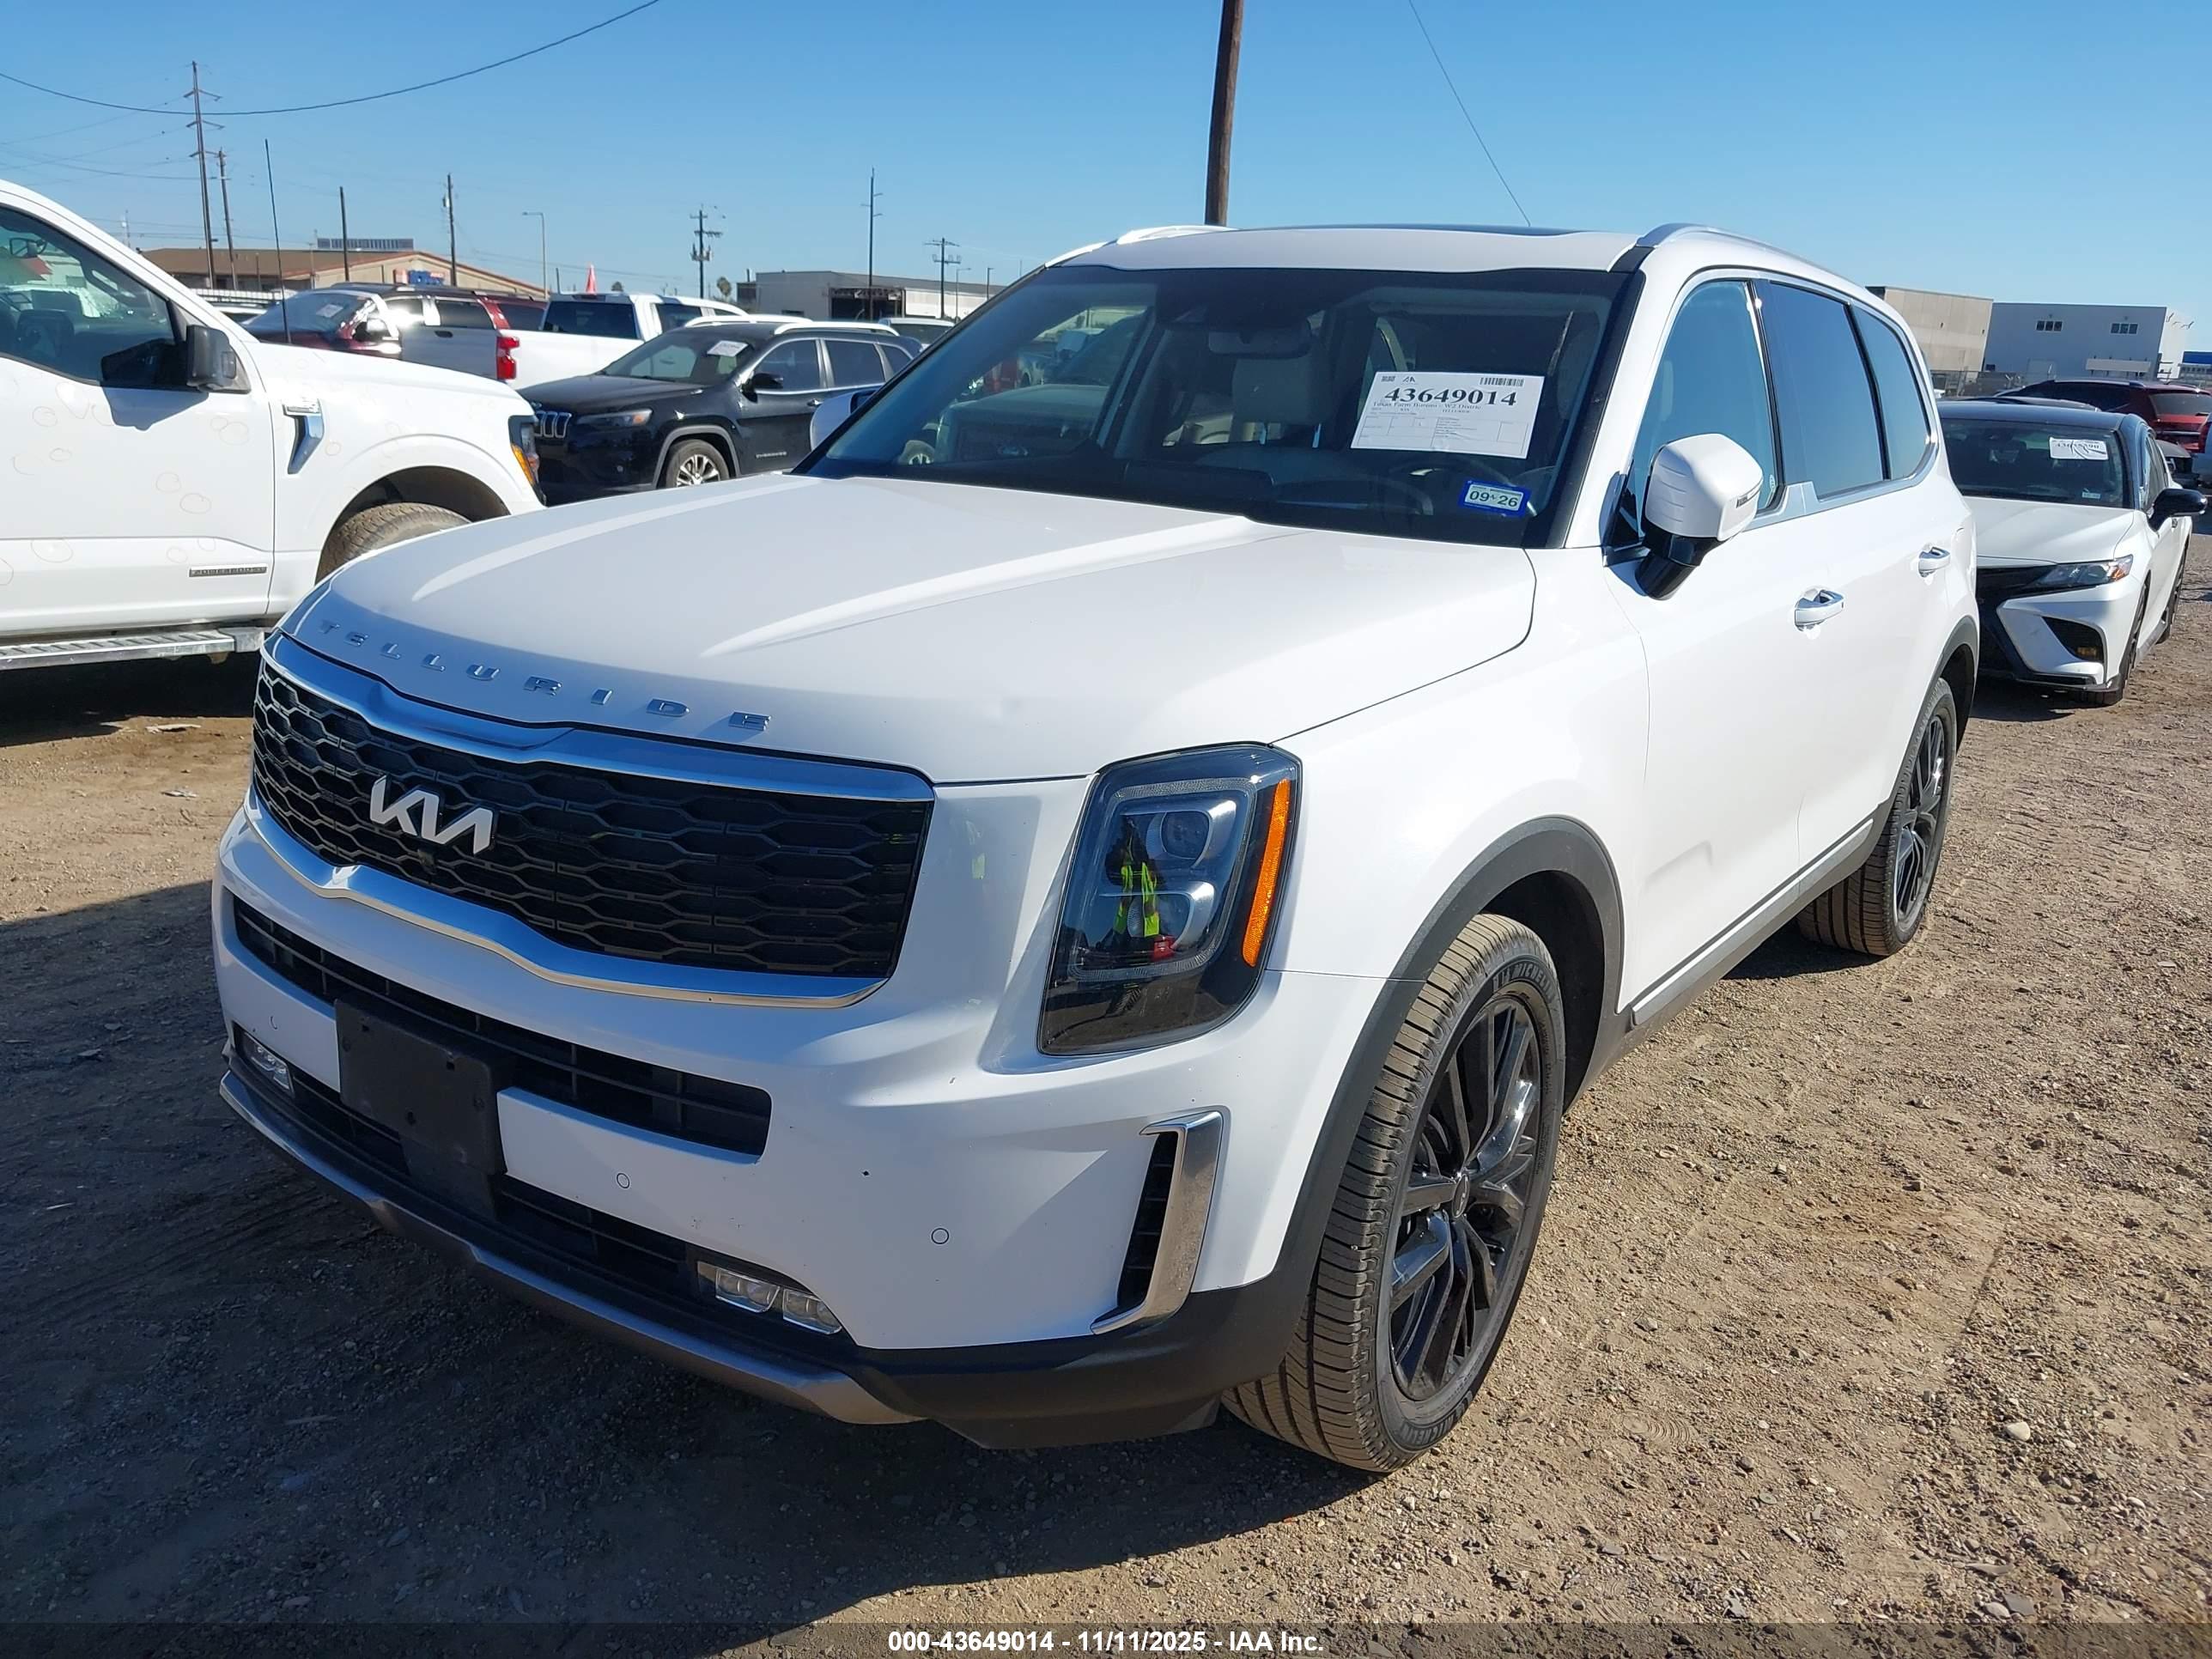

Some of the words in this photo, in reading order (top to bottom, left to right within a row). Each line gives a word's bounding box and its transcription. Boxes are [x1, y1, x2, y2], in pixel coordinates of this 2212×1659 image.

[1384, 387, 1517, 406] 43649014
[1469, 490, 1490, 501] 09
[1497, 495, 1518, 507] 26
[318, 622, 773, 732] TELLURIDE
[370, 775, 495, 855] KIA
